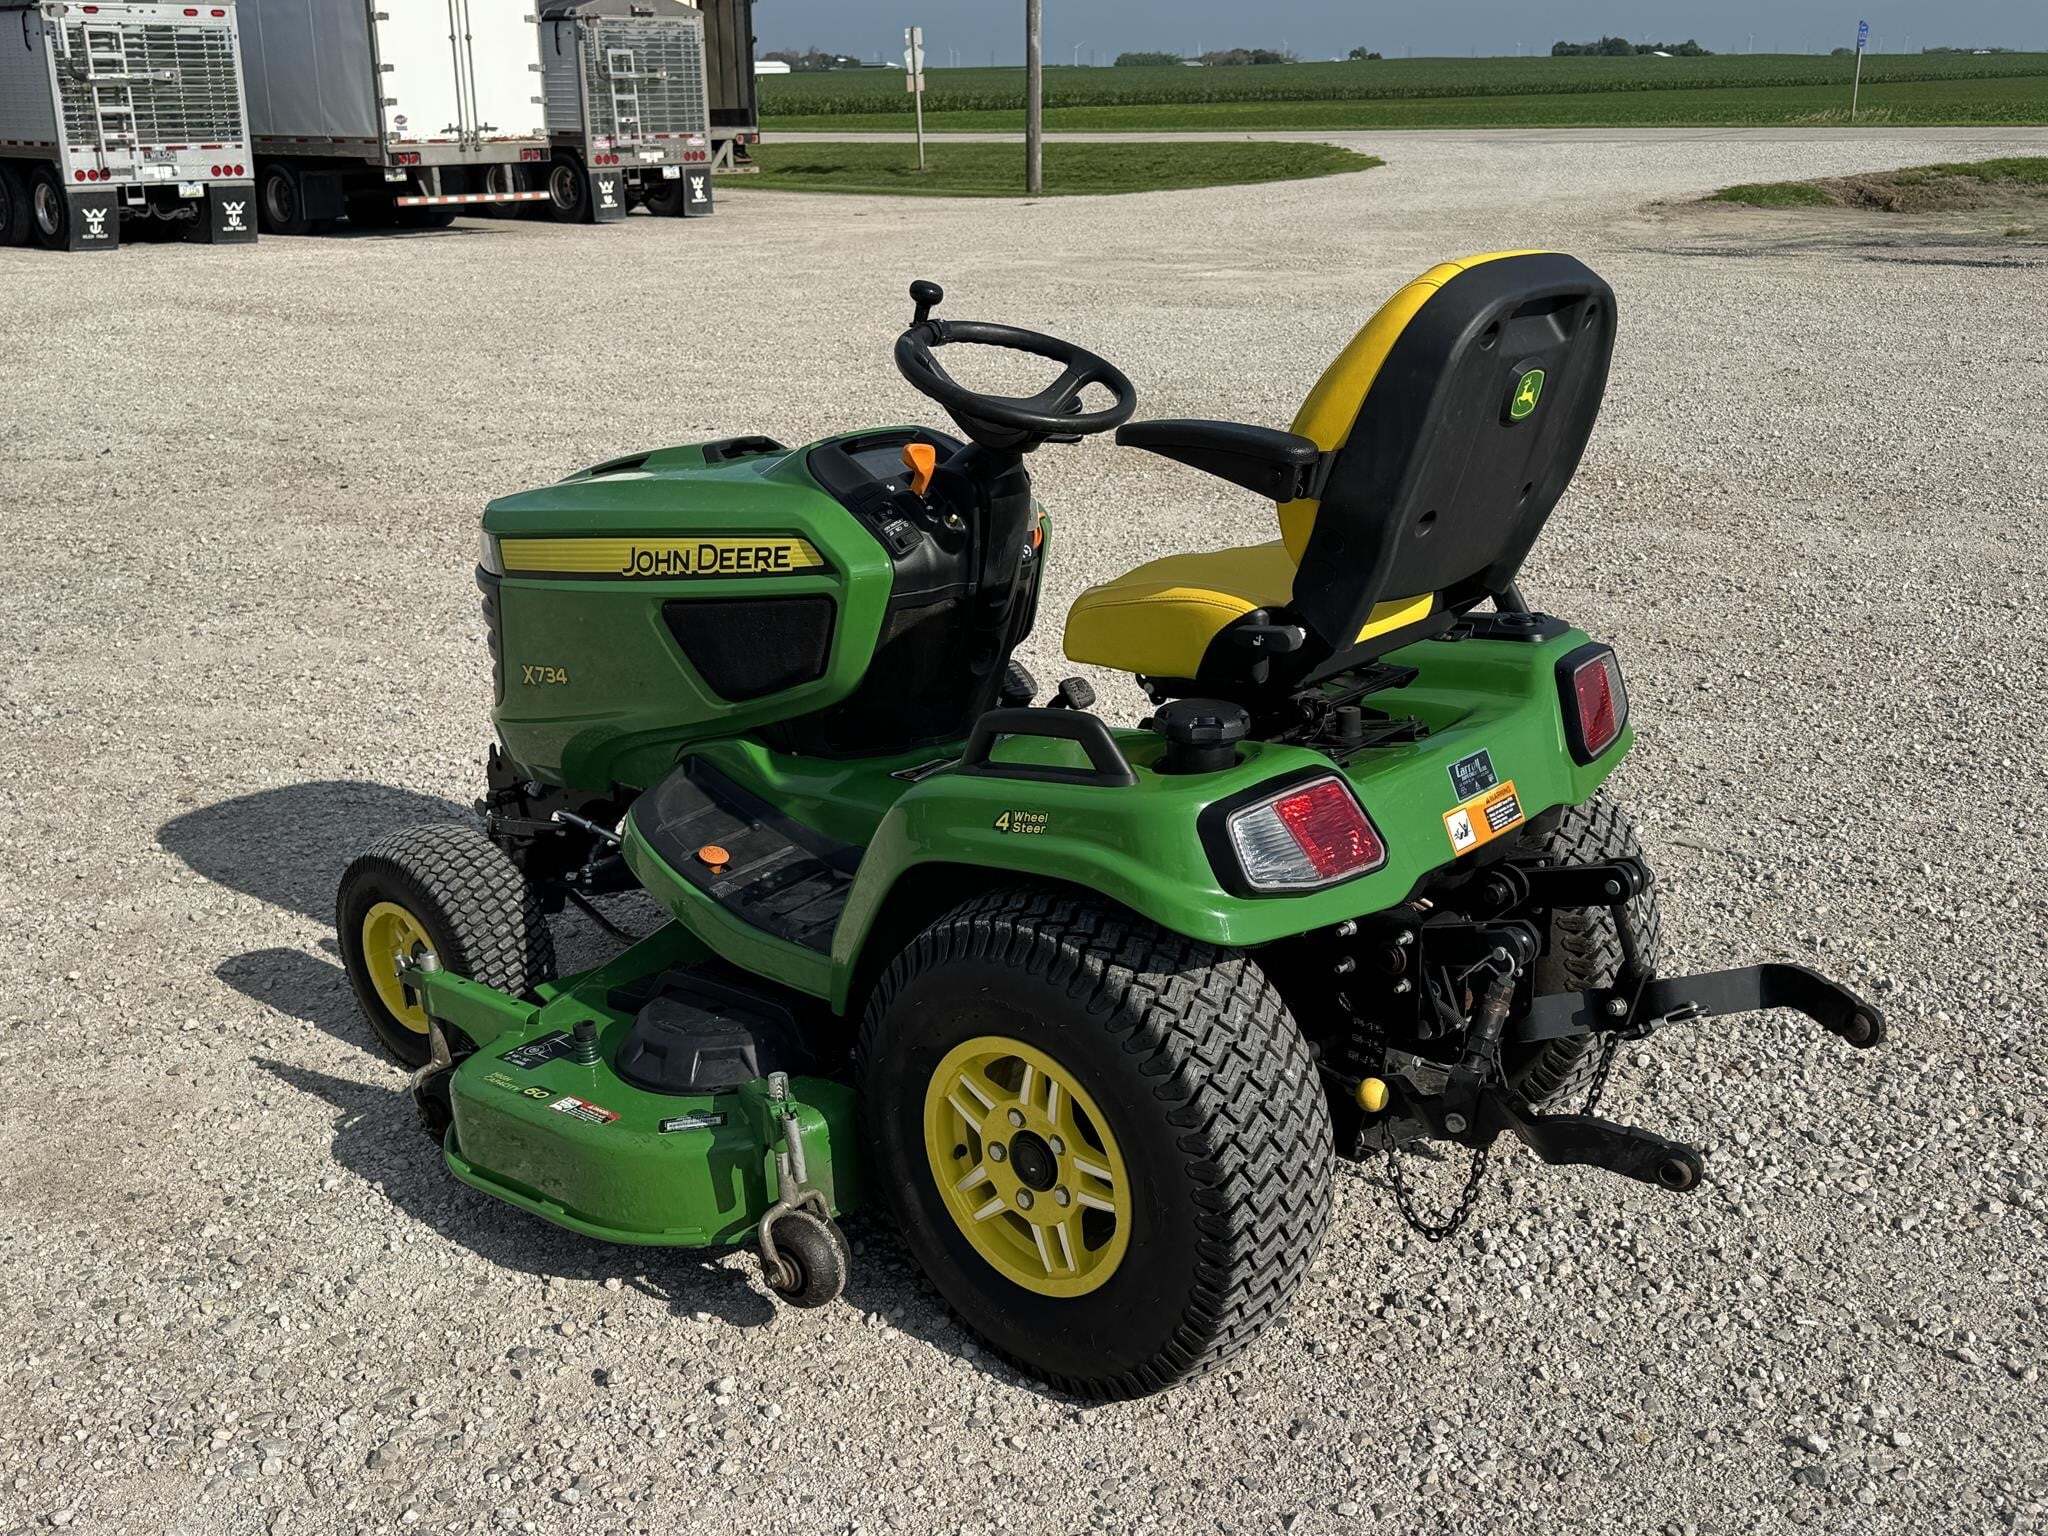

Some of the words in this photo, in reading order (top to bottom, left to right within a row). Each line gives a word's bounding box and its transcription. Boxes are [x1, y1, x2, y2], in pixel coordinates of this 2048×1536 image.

[622, 547, 692, 573] JOHN
[697, 544, 792, 570] DEERE
[521, 664, 568, 685] X734
[995, 811, 1010, 831] 4
[1014, 811, 1049, 823] Wheel
[1012, 822, 1047, 834] Steer
[523, 1087, 550, 1099] 60
